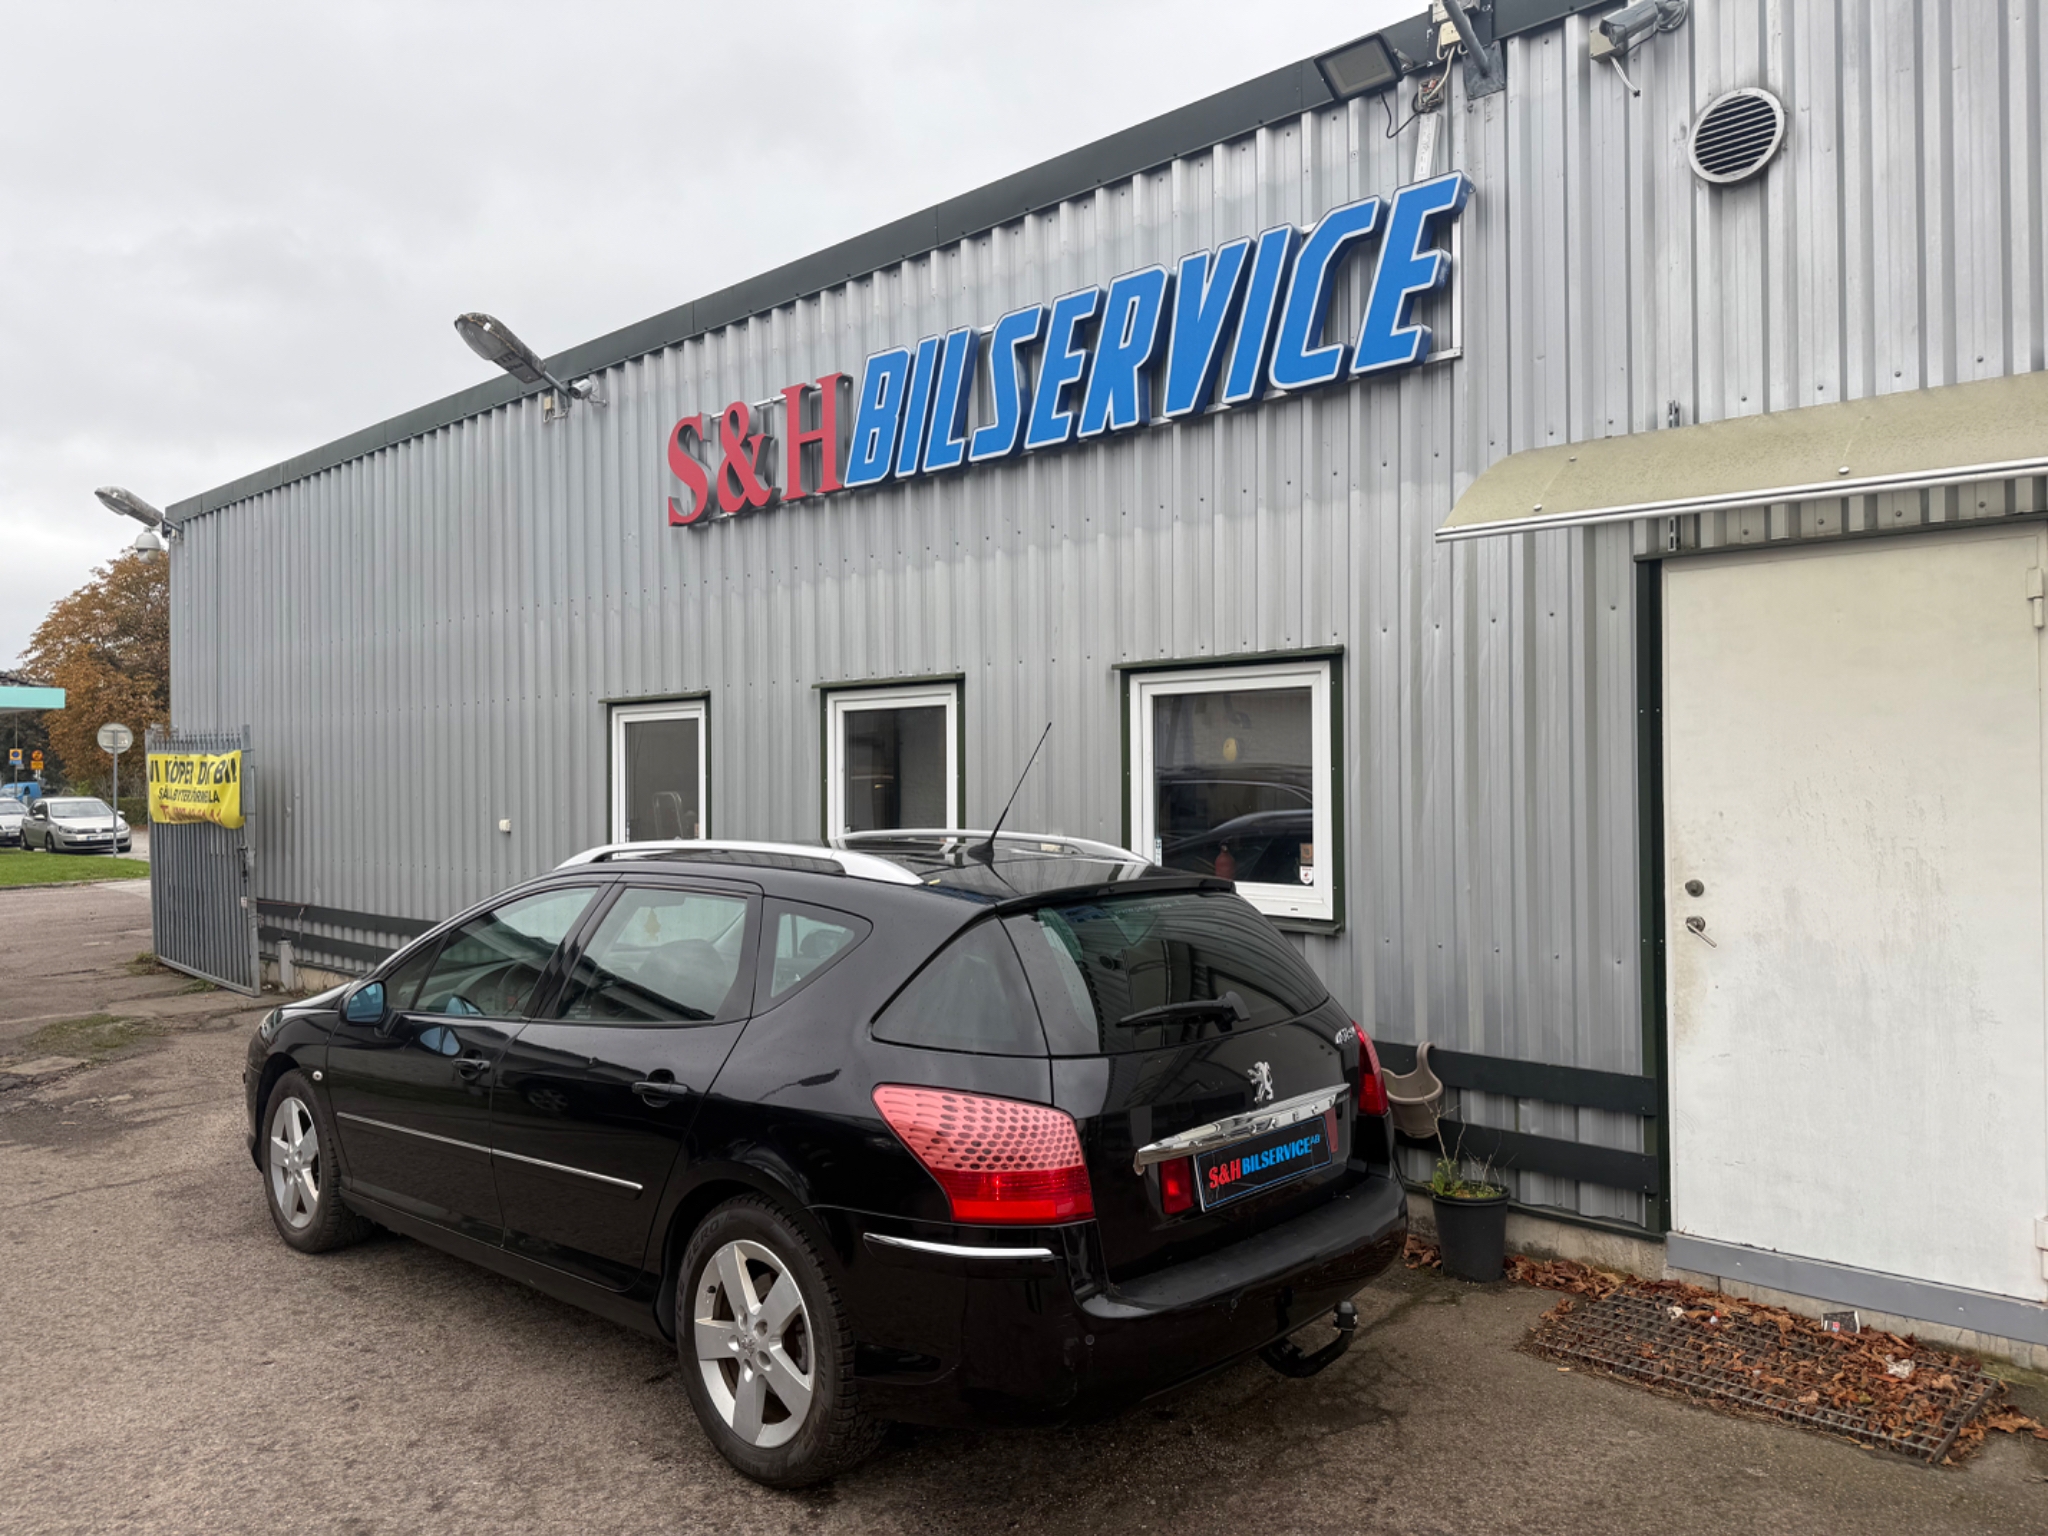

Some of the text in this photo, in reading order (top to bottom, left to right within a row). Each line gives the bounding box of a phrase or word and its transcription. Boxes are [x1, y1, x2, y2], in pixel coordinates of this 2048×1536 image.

[667, 169, 1472, 527] S&H BILSERVICE
[1208, 1158, 1242, 1190] S&H
[1242, 1137, 1312, 1176] BILSERVICE
